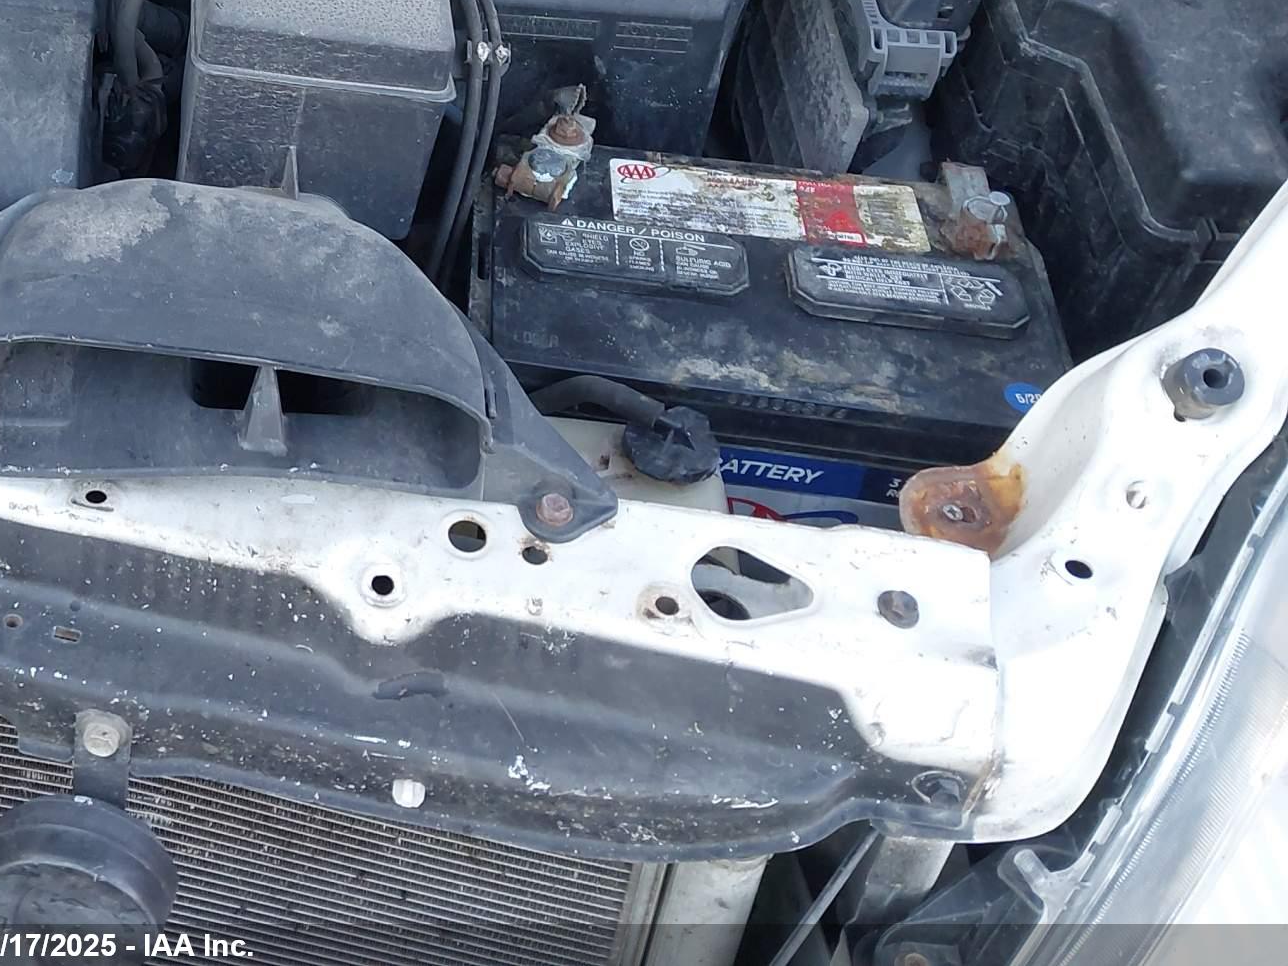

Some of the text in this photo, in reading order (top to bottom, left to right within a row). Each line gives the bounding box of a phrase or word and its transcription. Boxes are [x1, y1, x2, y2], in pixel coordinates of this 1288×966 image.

[618, 164, 656, 180] AAA
[576, 220, 635, 234] DANGER
[651, 229, 705, 242] POISON
[564, 241, 604, 250] EXPLOSIVE
[565, 246, 591, 254] GASES
